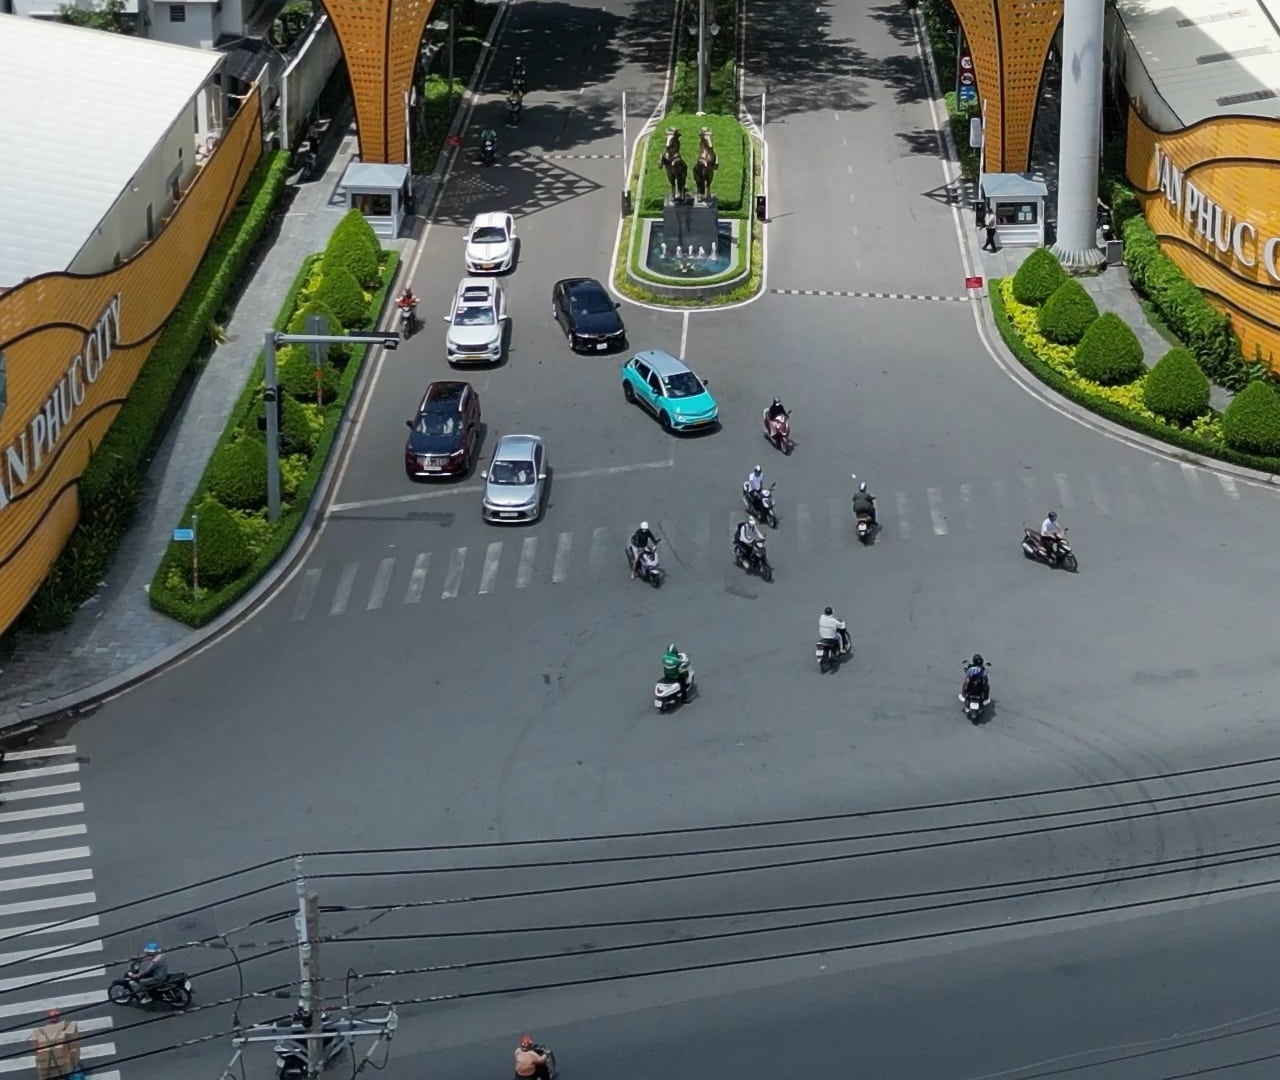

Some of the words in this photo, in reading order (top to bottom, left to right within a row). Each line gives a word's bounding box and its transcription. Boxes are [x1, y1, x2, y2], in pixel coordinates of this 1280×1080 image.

[1155, 143, 1184, 210] VAN
[1186, 181, 1256, 267] PHUC
[31, 355, 86, 471] PHUC
[84, 292, 122, 384] CITY
